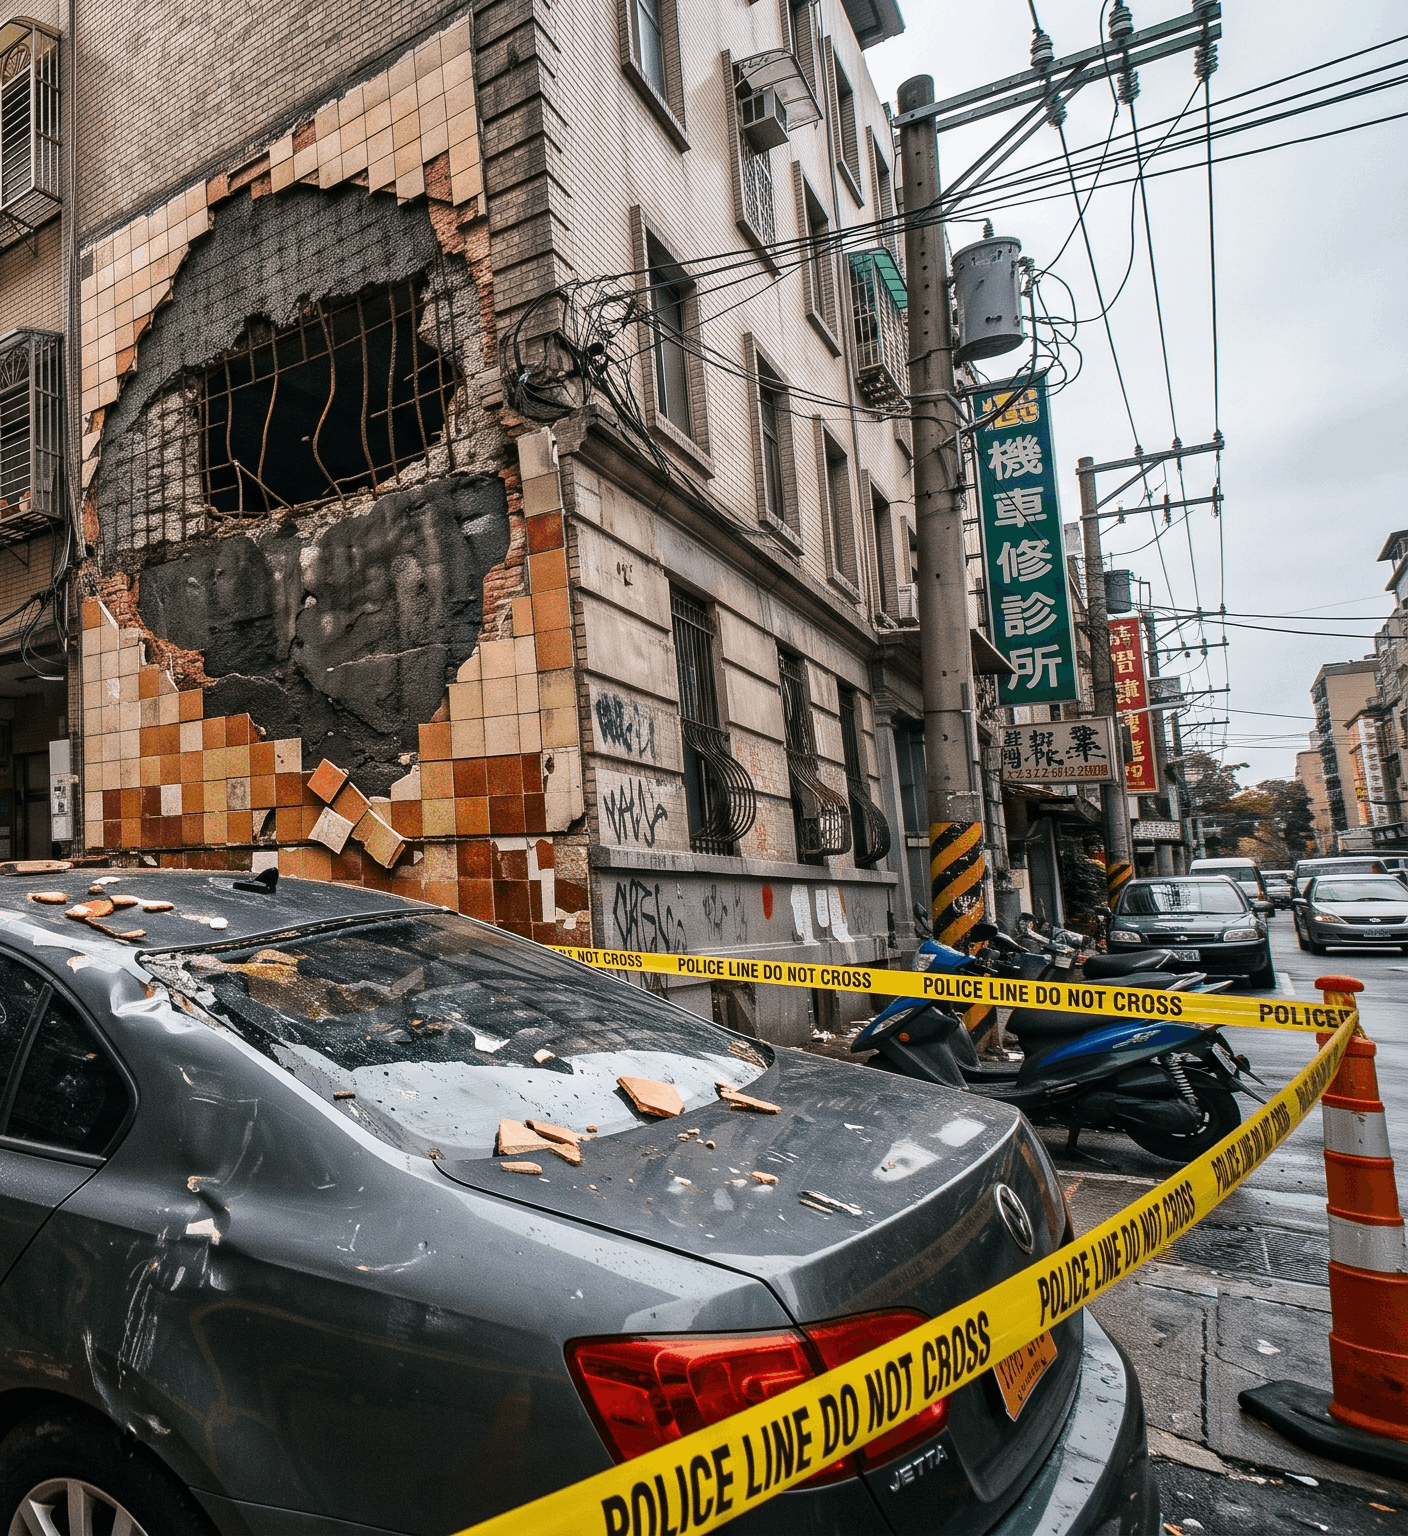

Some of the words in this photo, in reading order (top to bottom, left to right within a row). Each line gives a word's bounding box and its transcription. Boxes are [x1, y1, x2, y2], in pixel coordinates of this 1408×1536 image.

[988, 434, 1063, 691] 機車修診所
[577, 950, 599, 964] NOT
[603, 952, 643, 968] CROSS
[677, 957, 725, 976] POLICE
[728, 961, 759, 979] LINE
[763, 964, 783, 981] DO
[787, 966, 817, 984] NOT
[820, 968, 873, 989] CROSS
[922, 976, 984, 999] POLICE
[989, 981, 1029, 1003] LINE
[1035, 985, 1061, 1006] DO
[1067, 989, 1107, 1009] NOT
[1113, 991, 1183, 1017] CROSS
[1258, 1003, 1340, 1029] POLICE
[1037, 1251, 1091, 1328] POLICE
[1090, 1230, 1122, 1291] LINE
[1120, 1218, 1141, 1271] DO
[1138, 1202, 1163, 1258] NOT
[1162, 1179, 1196, 1240] CROSS
[601, 1443, 735, 1536] POLICE
[741, 1405, 813, 1501] LINE
[817, 1382, 861, 1460] DO
[864, 1351, 914, 1434] NOT
[921, 1310, 992, 1401] CROSS
[889, 1444, 949, 1493] JETTA
